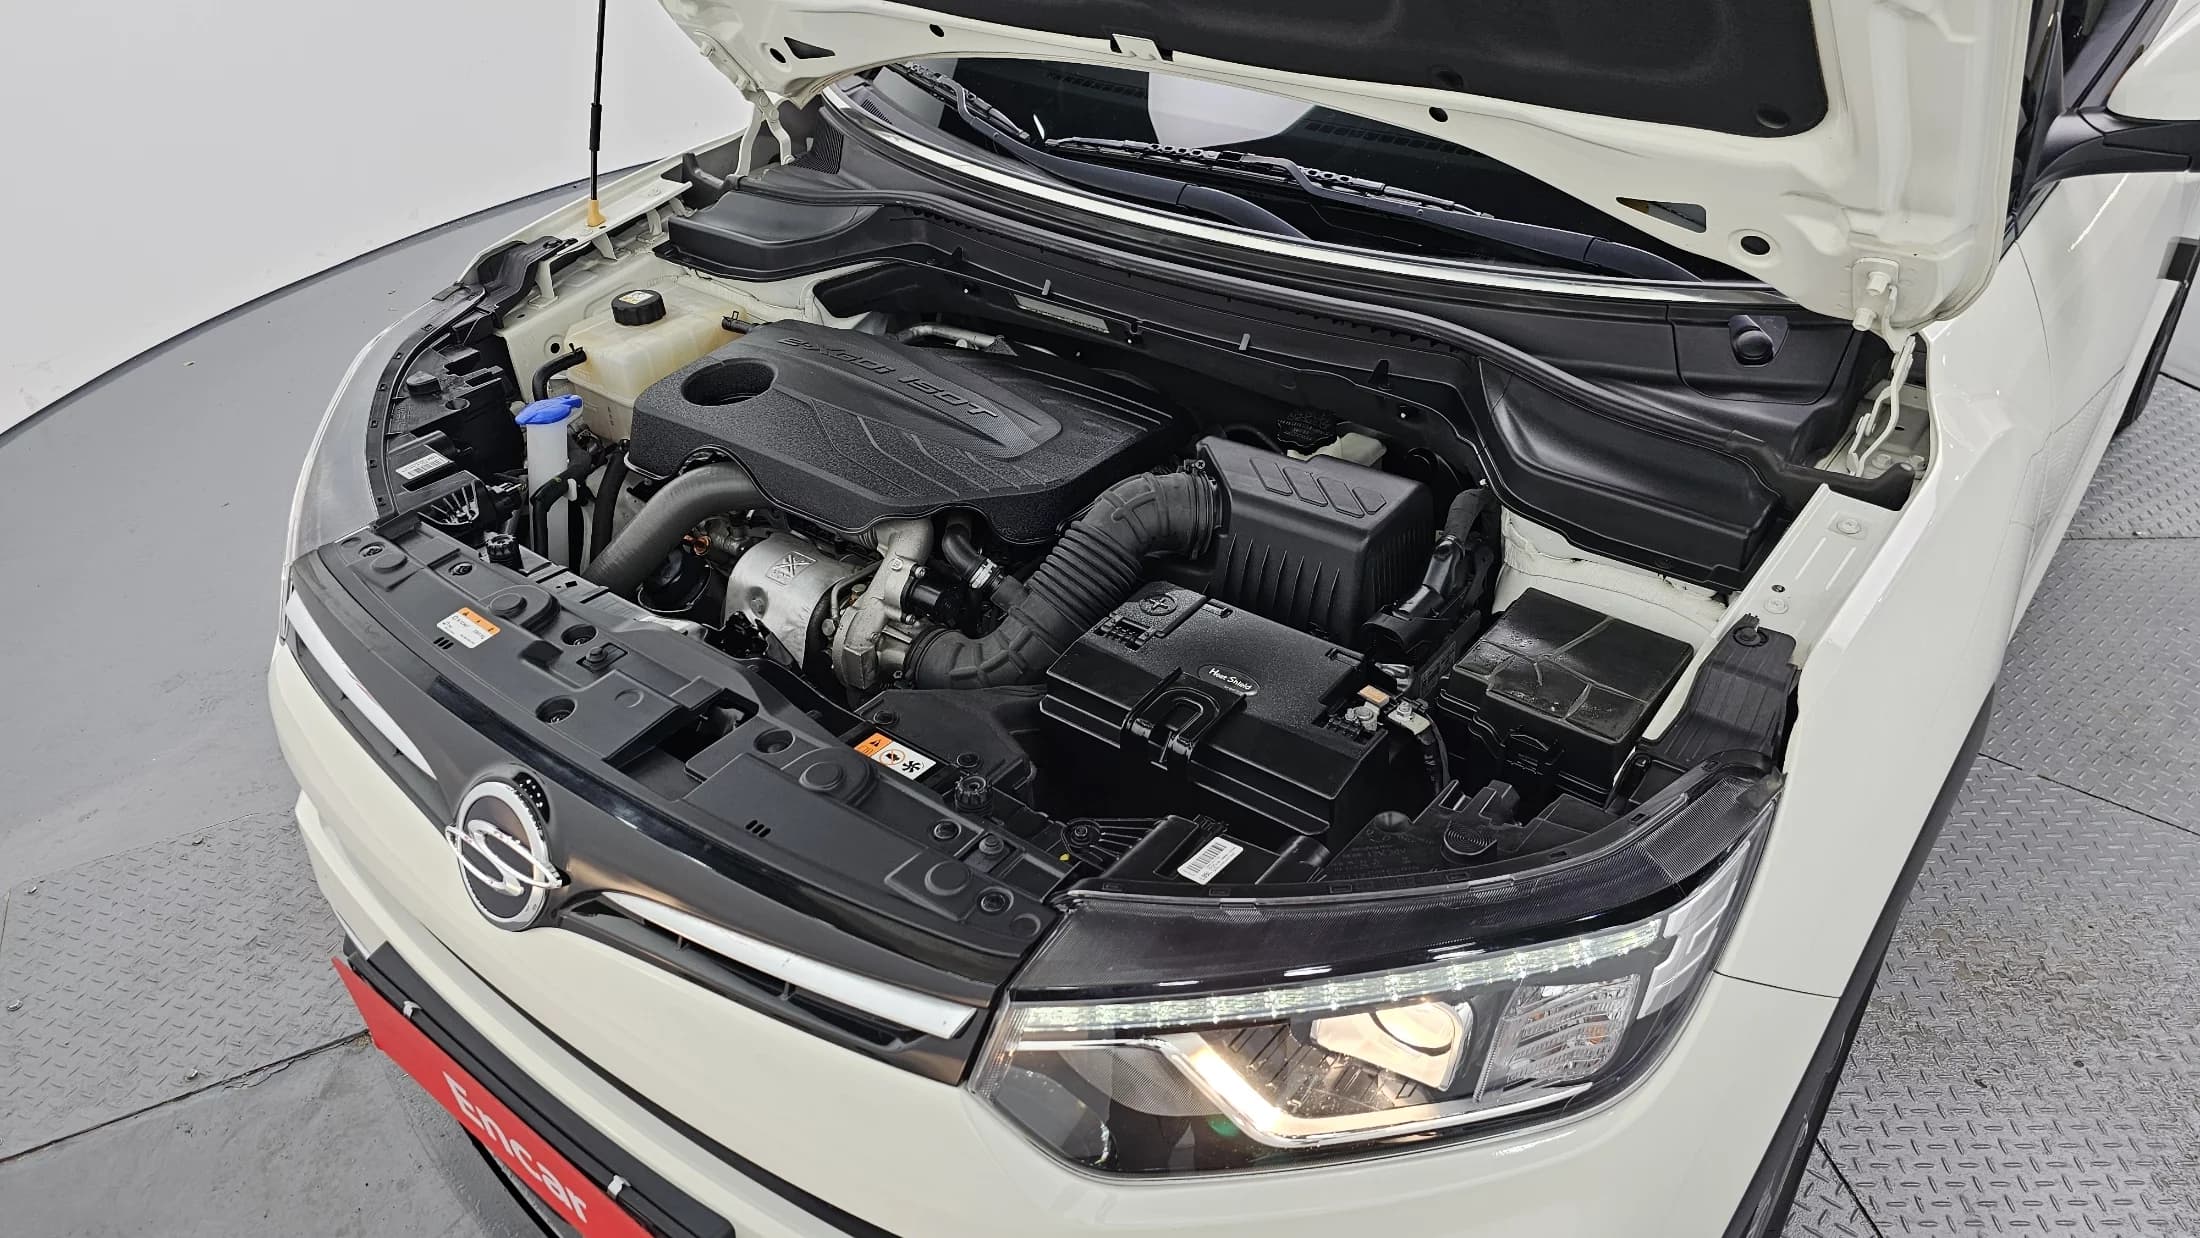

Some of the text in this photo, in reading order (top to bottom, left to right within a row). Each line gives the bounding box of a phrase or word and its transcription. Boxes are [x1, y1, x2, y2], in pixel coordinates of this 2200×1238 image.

[1208, 667, 1227, 681] Heat
[1227, 676, 1253, 690] Shield
[442, 1070, 588, 1224] Encar
